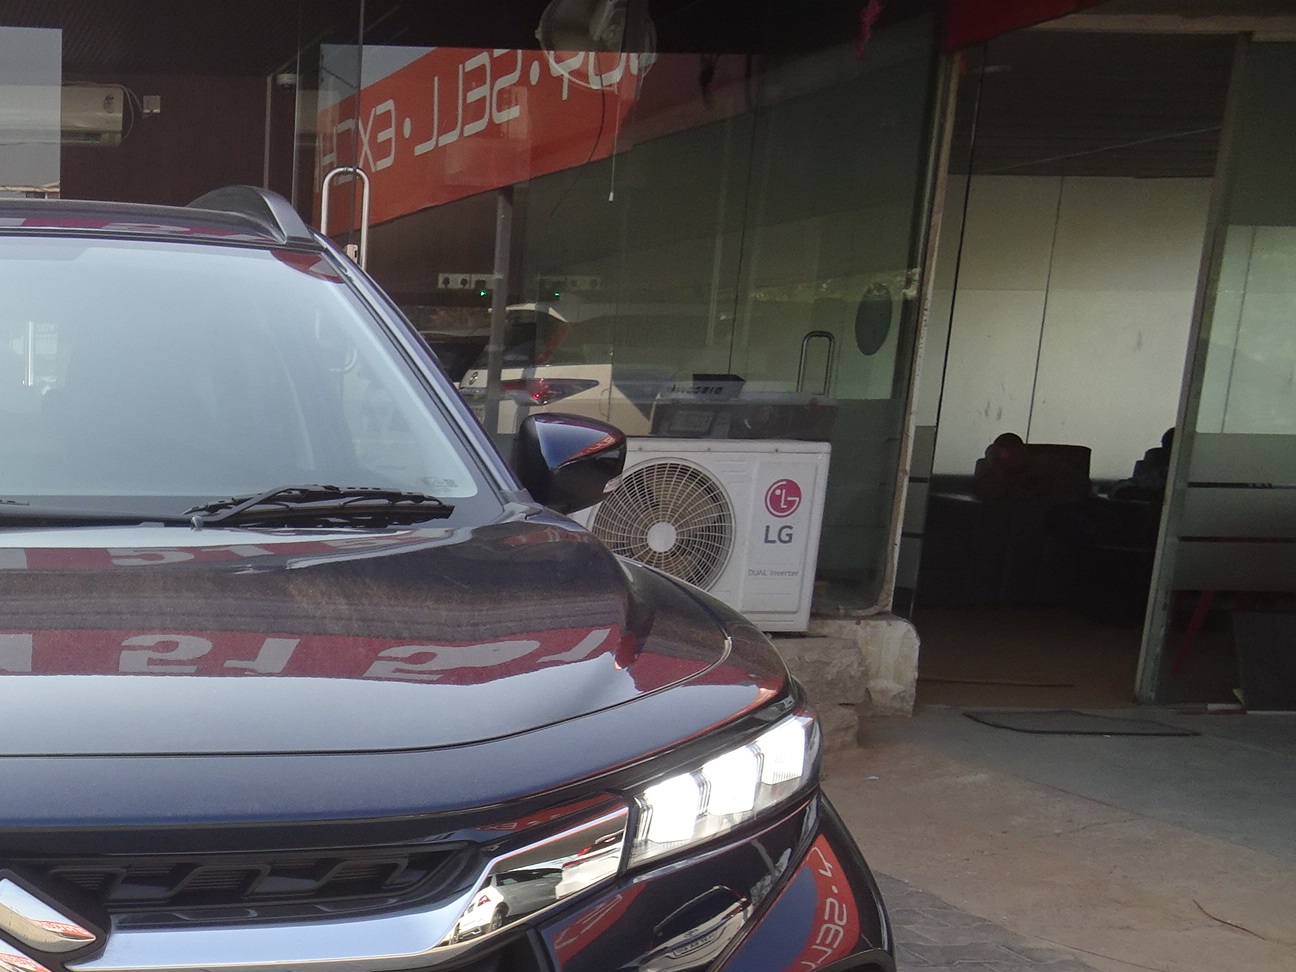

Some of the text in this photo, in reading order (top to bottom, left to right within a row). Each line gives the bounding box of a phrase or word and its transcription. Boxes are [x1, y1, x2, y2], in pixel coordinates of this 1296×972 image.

[764, 525, 794, 544] LG
[748, 569, 799, 577] DUAL Inverter
